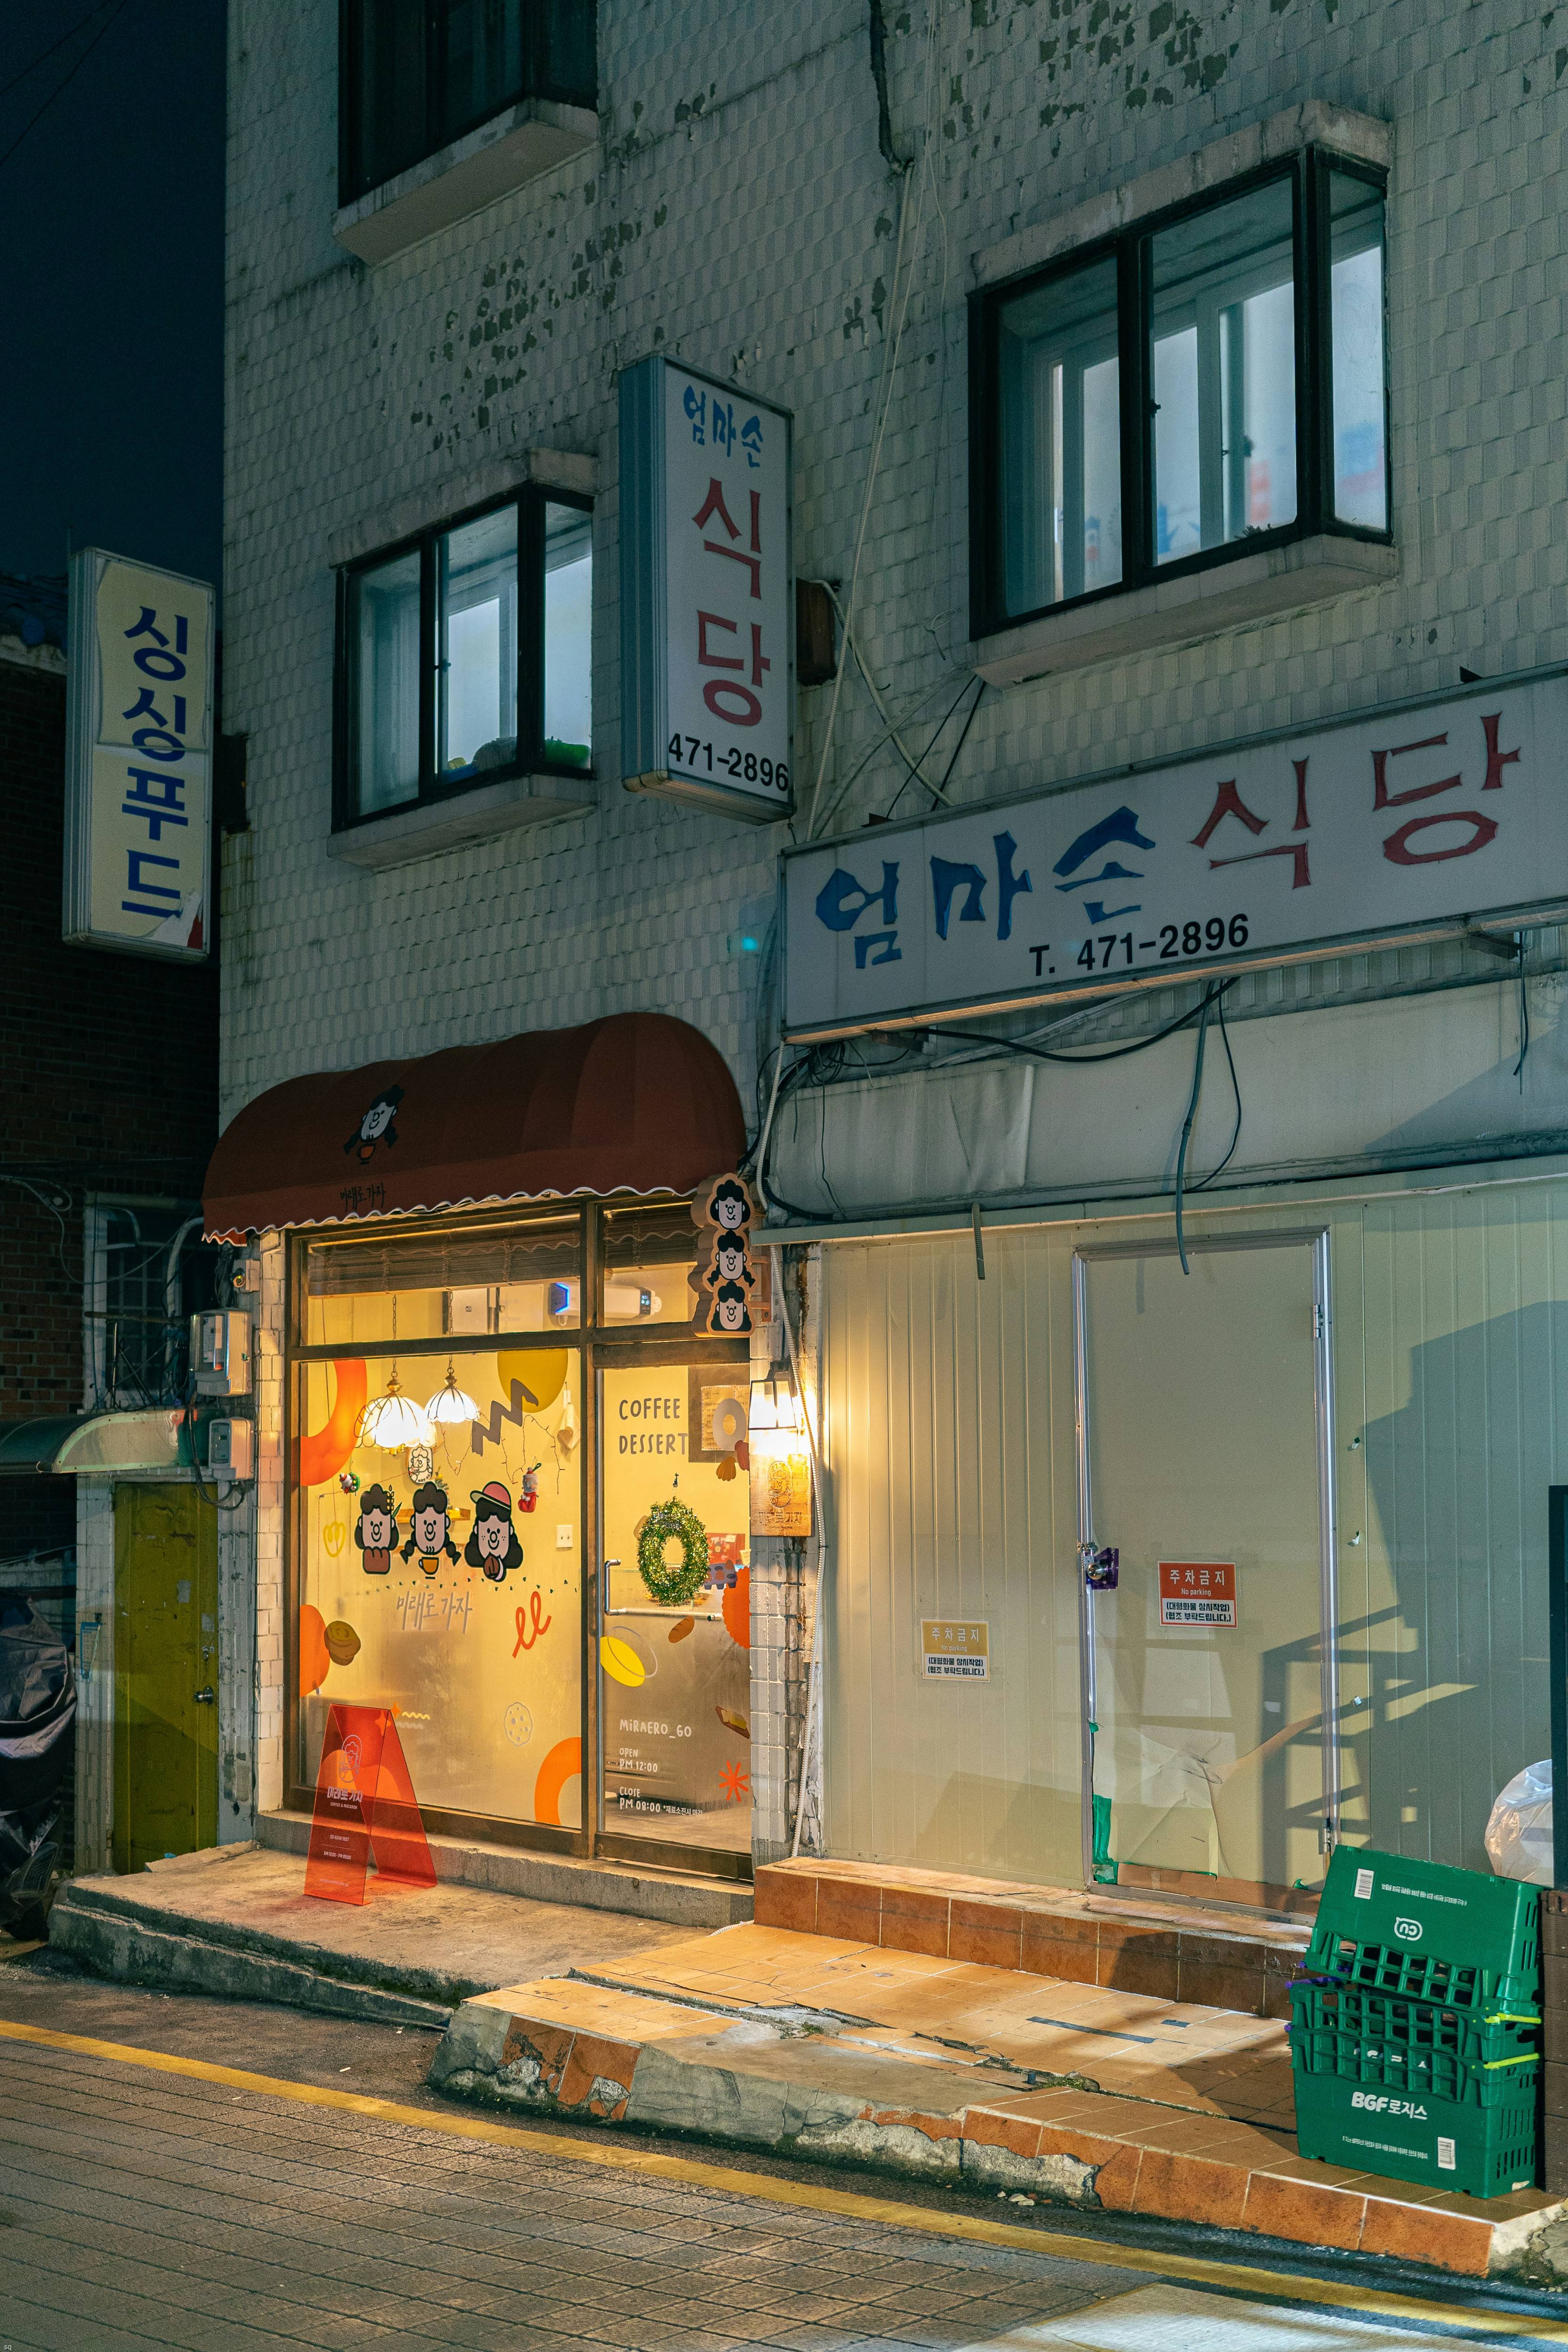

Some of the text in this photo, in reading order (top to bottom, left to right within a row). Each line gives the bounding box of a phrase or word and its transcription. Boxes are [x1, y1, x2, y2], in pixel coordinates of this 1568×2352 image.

[683, 384, 763, 468] 엄마손
[692, 477, 771, 727] 식당
[122, 606, 188, 918] 싱싱푸드
[668, 732, 789, 792] 471-2896
[816, 711, 1521, 969] 엄마손 식당
[1029, 913, 1248, 976] T. 471-2896
[366, 1181, 387, 1208] 가자
[620, 1398, 680, 1420] COFFEE
[619, 1433, 691, 1454] DESSERT
[397, 1591, 473, 1634] 미래로 가자
[1166, 1612, 1231, 1622] (협조 부탁드립니다.)
[1199, 1603, 1230, 1612] 상시작업)
[944, 1667, 985, 1676] 부탁드립니다.)
[956, 1658, 983, 1667] 상시작업)
[619, 1748, 639, 1758] OPEN
[620, 1758, 658, 1772] PM 12:00
[327, 1786, 348, 1801] 미래로
[619, 1787, 640, 1797] CLOSE
[620, 1797, 633, 1810] PM
[636, 1800, 661, 1812] 08:00
[1351, 2091, 1427, 2120] BGF로지스
